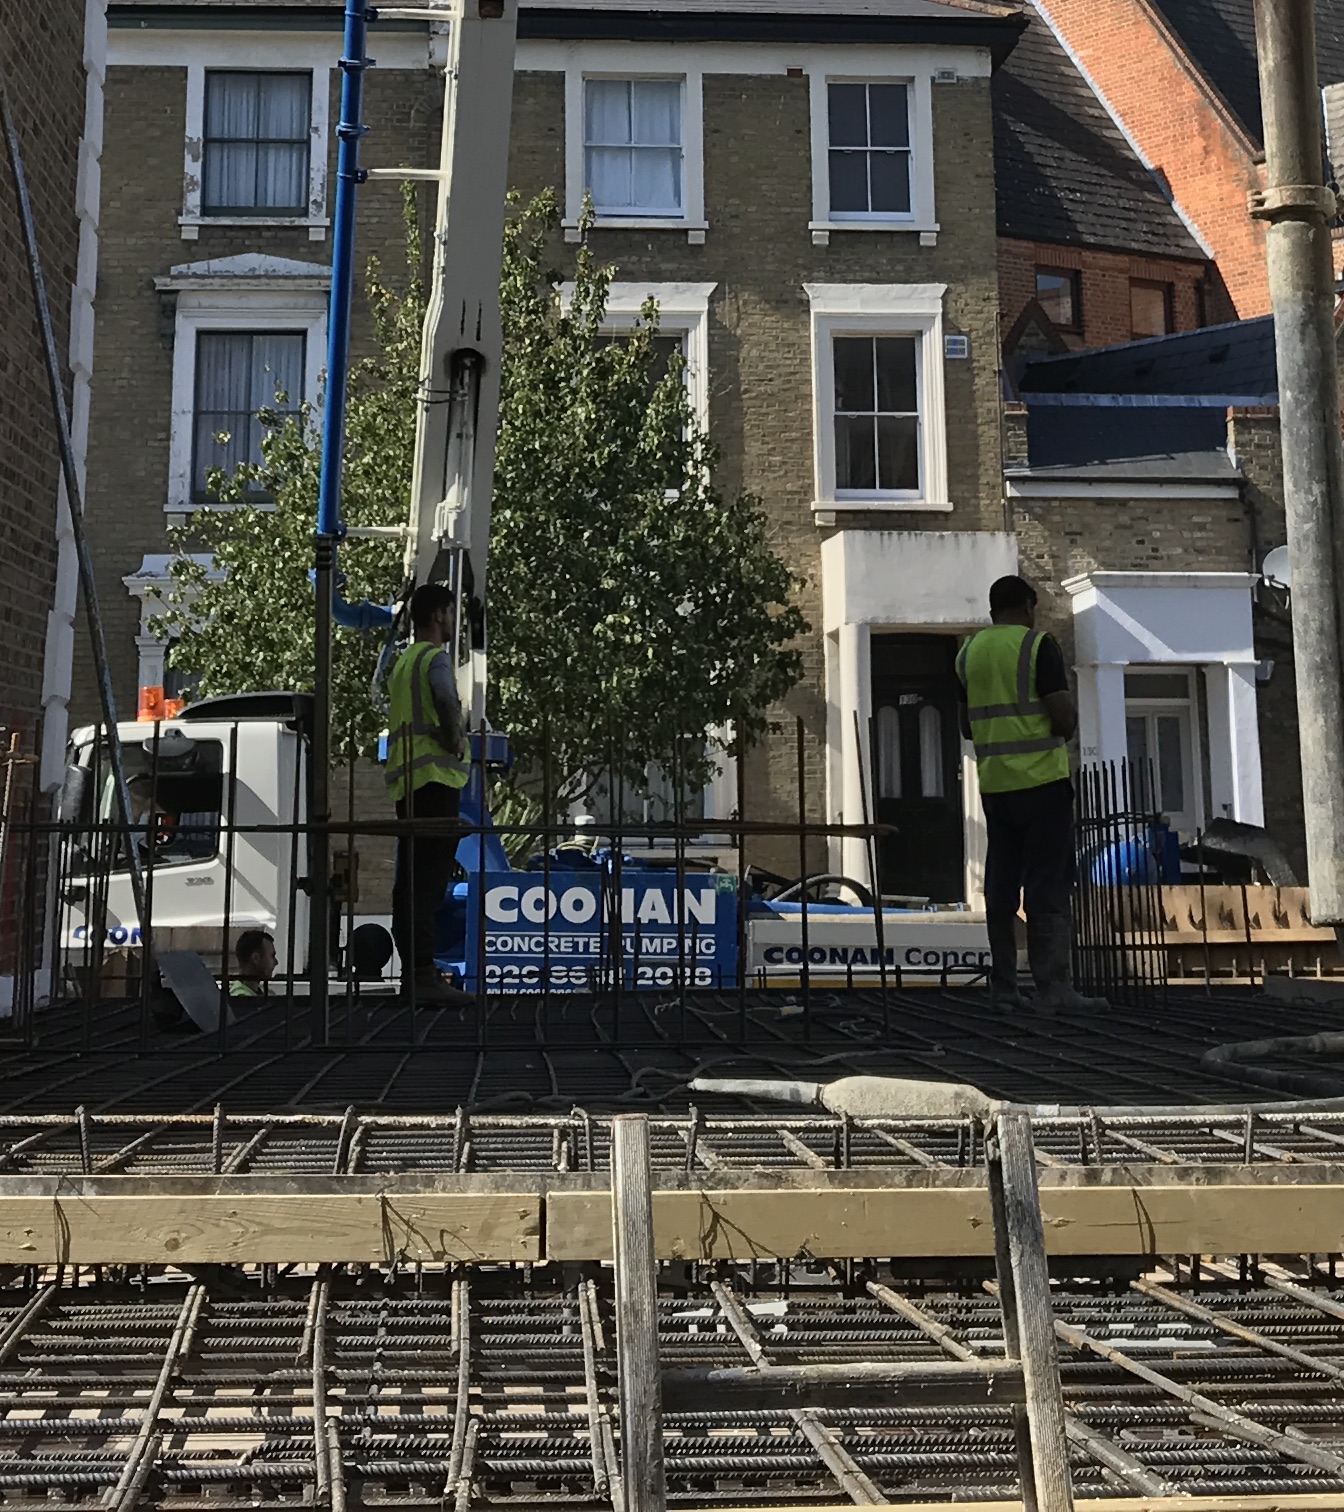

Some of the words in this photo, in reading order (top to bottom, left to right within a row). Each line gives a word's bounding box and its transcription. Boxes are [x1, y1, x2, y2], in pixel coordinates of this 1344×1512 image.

[485, 886, 716, 924] COONAN
[485, 936, 601, 953] CONCRETE
[613, 937, 716, 954] UMPNG
[763, 946, 895, 966] COONAN
